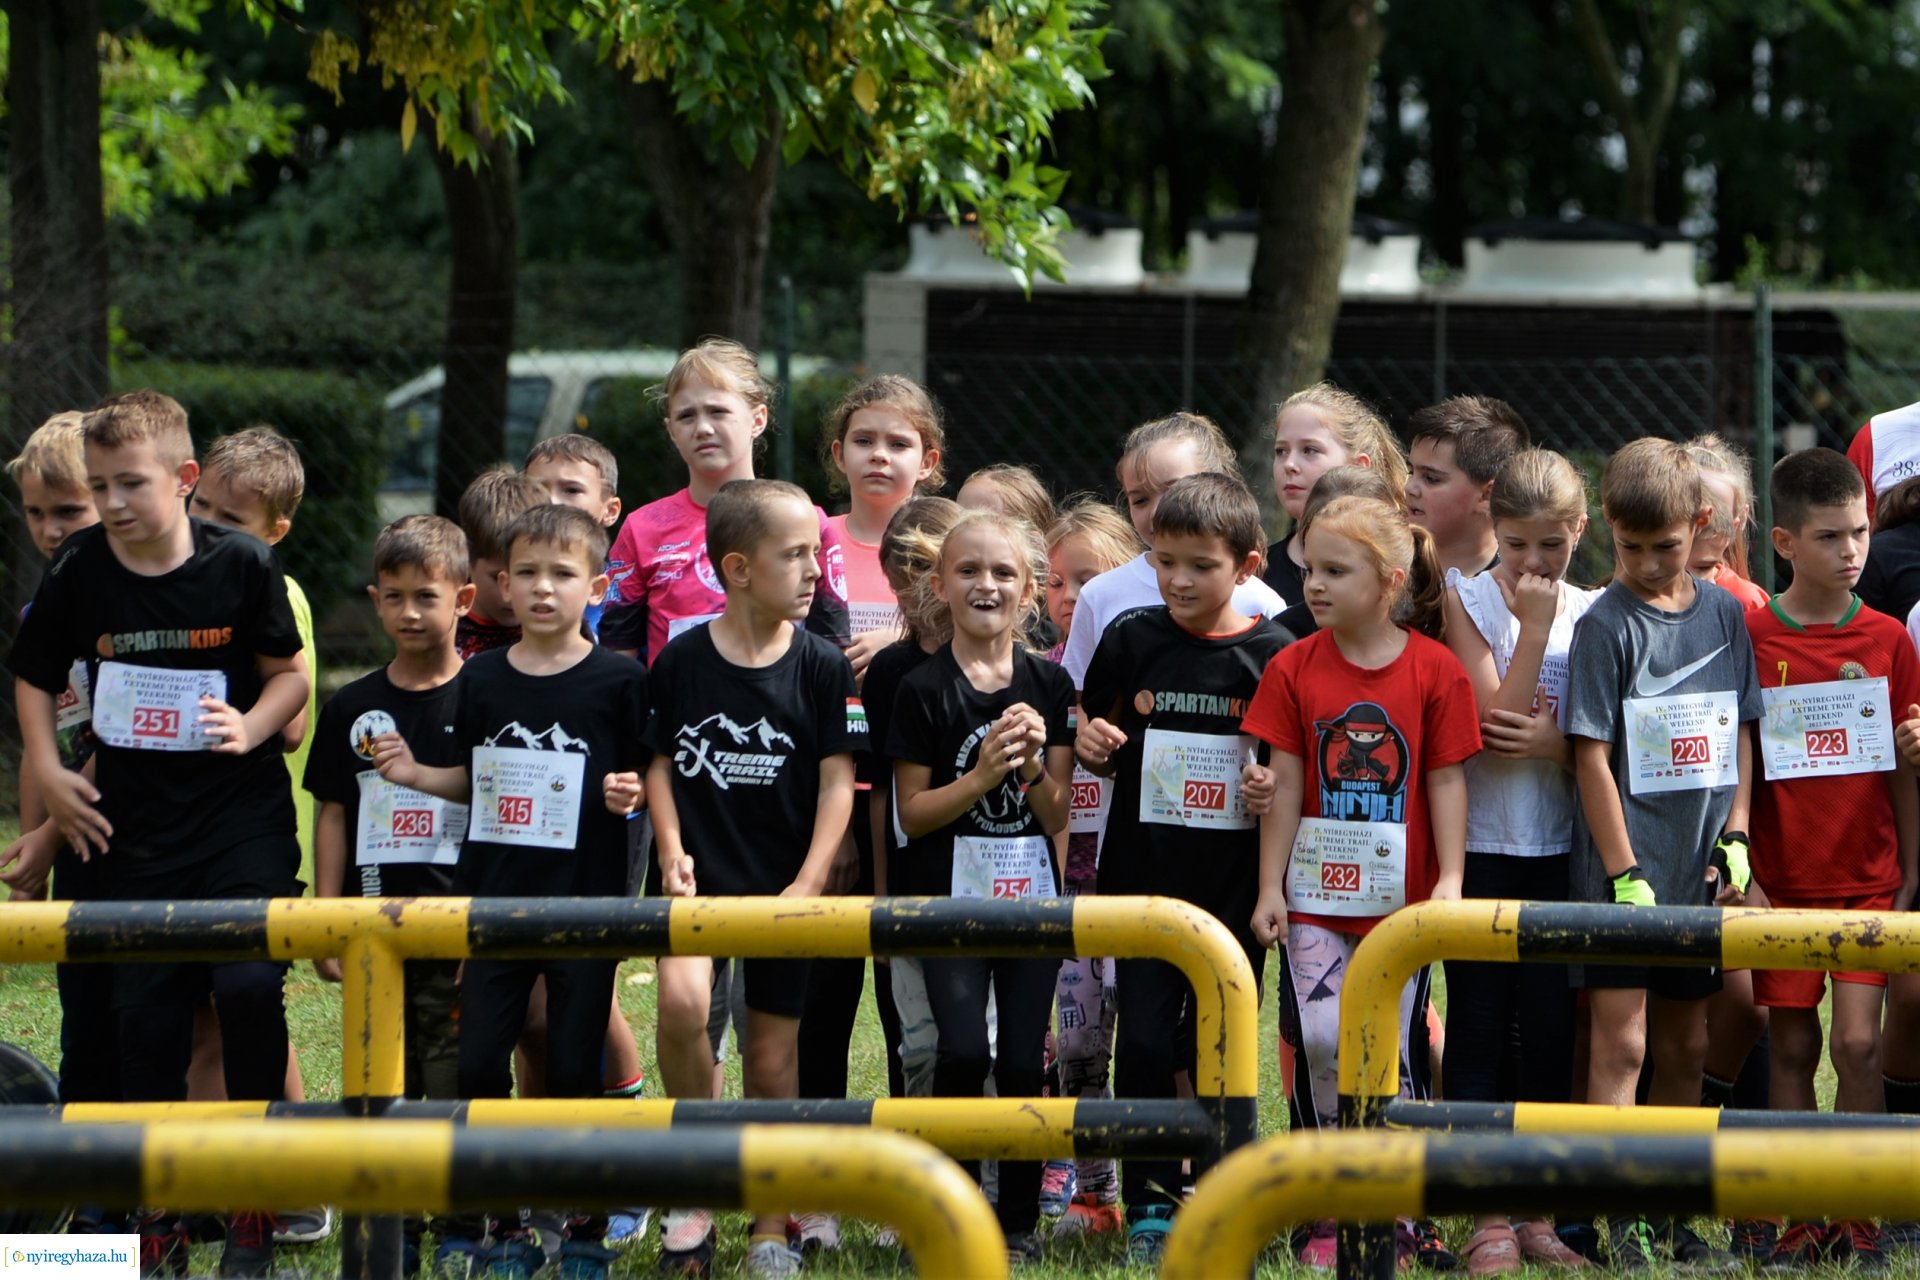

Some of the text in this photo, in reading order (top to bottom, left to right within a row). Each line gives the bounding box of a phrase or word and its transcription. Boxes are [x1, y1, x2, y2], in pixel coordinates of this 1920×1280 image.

[113, 626, 233, 655] SPARTANKIDS
[1792, 701, 1854, 714] EXTREME TRAIL
[1804, 710, 1844, 721] WEEKEND
[133, 710, 178, 734] 251
[1669, 718, 1706, 728] WEEKEND
[1673, 738, 1708, 764] 220
[1807, 731, 1846, 756] 223
[1175, 754, 1237, 766] EXTREME TRAIL
[1186, 763, 1227, 773] WEEKEND
[718, 763, 779, 778] TRAIL
[1341, 780, 1381, 791] BUDAPEST
[1071, 785, 1099, 807] 250
[1185, 784, 1223, 807] 207
[499, 798, 531, 823] 215
[395, 812, 431, 836] 236
[1322, 845, 1360, 854] WEEKEND
[1348, 838, 1370, 847] TRAIL
[993, 860, 1032, 869] WEEKEND
[1322, 865, 1358, 889] 232
[994, 881, 1030, 899] 254
